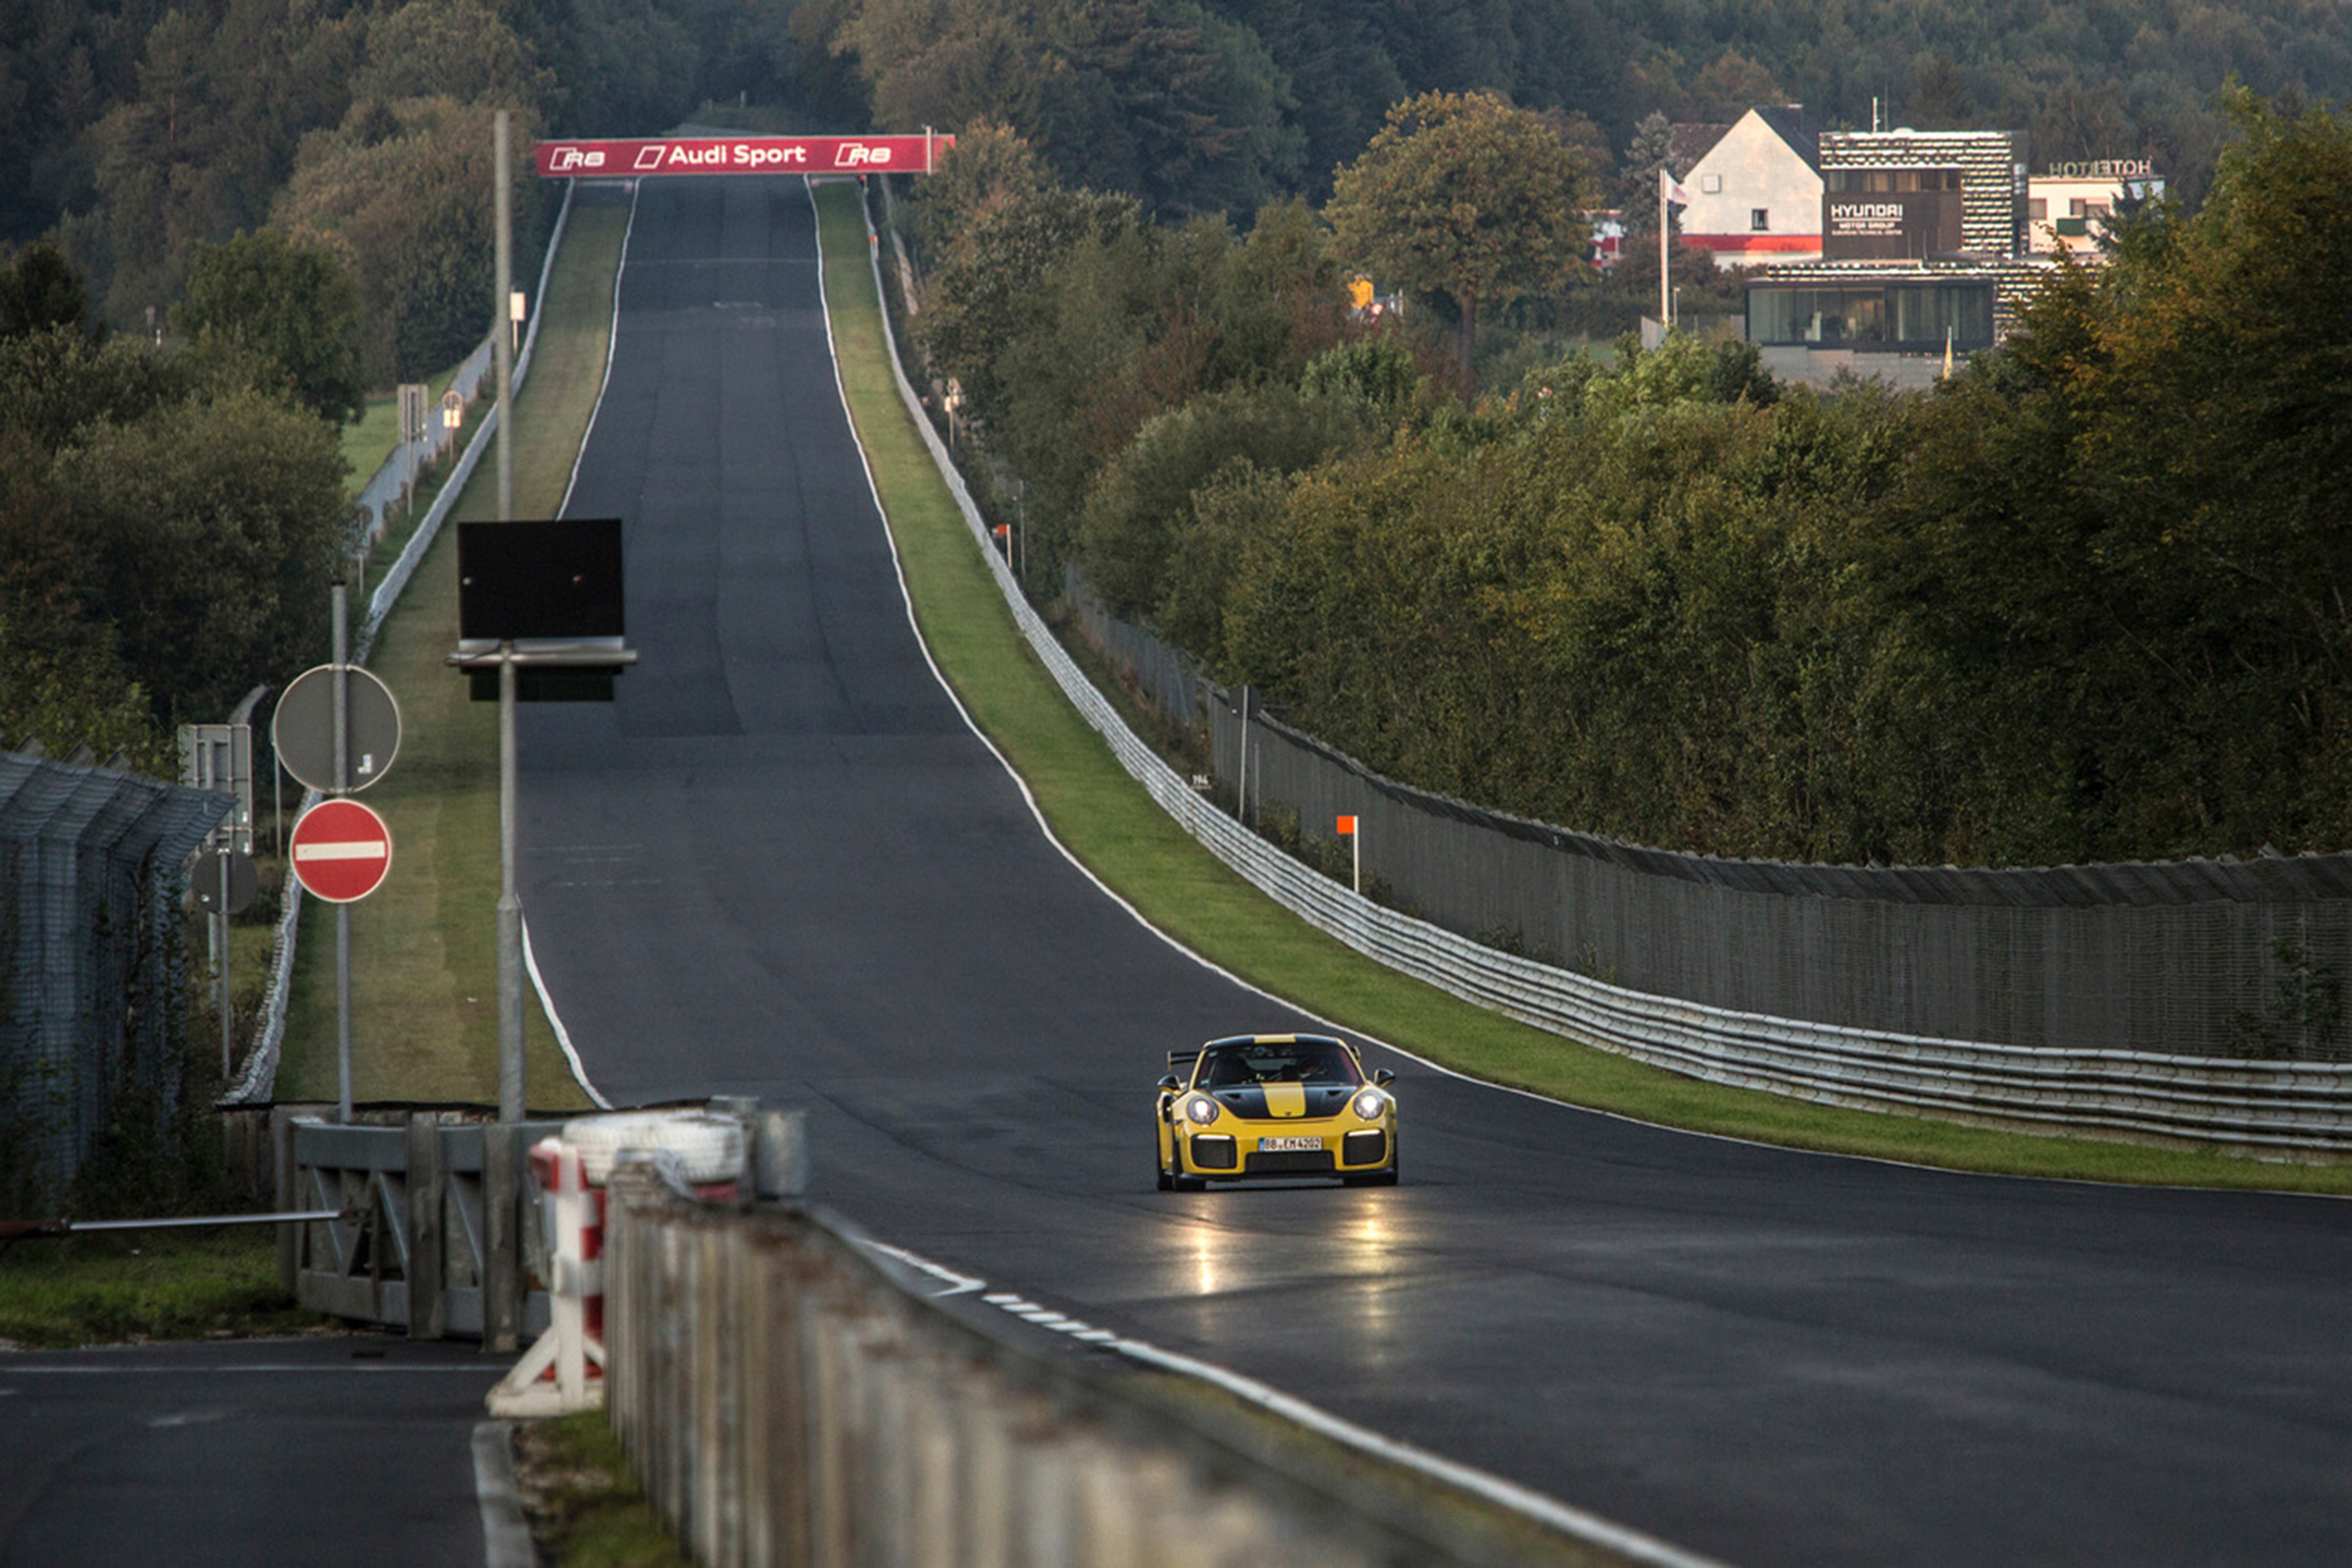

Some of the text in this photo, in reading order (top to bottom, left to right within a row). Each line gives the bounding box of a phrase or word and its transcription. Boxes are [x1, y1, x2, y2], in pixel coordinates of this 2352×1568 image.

[563, 151, 606, 168] R8
[667, 144, 808, 169] Audi Sport
[848, 147, 891, 164] R8
[1831, 204, 1903, 218] HYUNDAI
